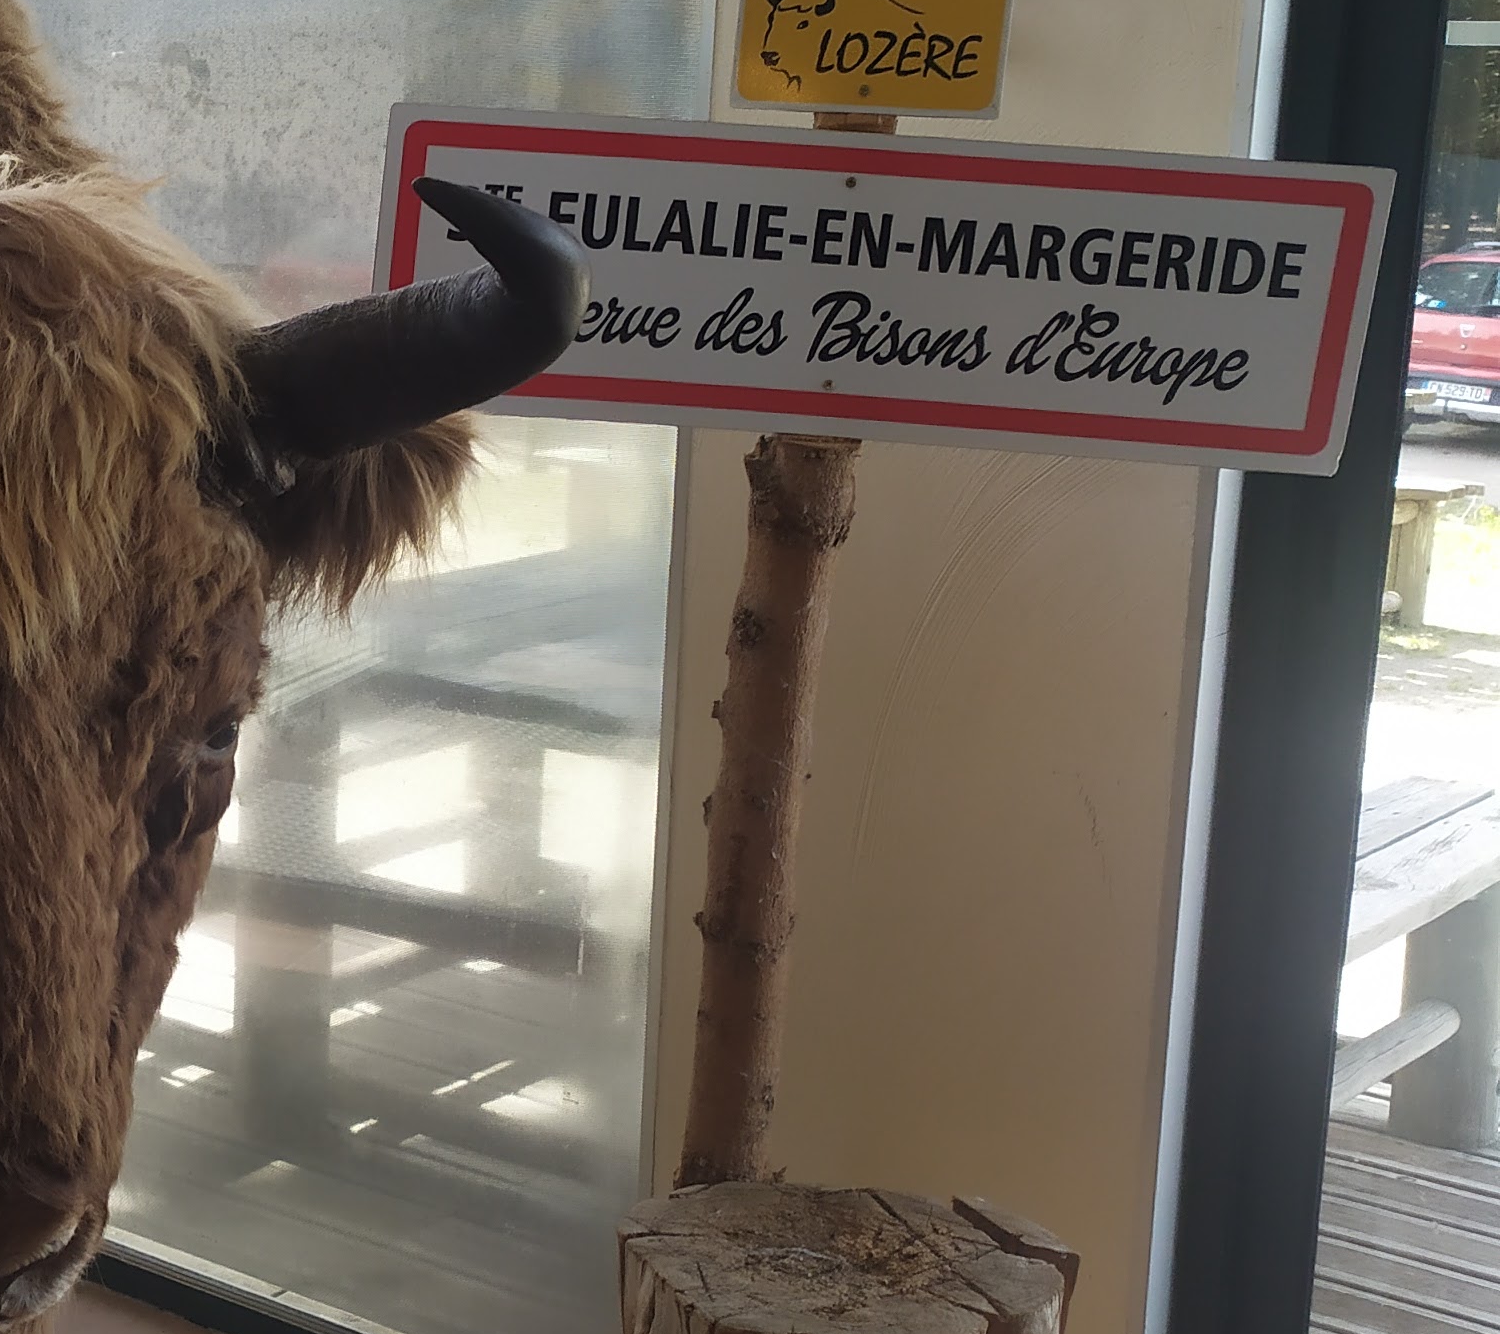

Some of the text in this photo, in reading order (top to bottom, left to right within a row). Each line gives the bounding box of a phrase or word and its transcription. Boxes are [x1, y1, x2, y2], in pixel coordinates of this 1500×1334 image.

[814, 22, 984, 82] LOZÈRE
[698, 286, 787, 355] des
[805, 290, 990, 374] Bisons
[1007, 304, 1250, 404] d'Europe
